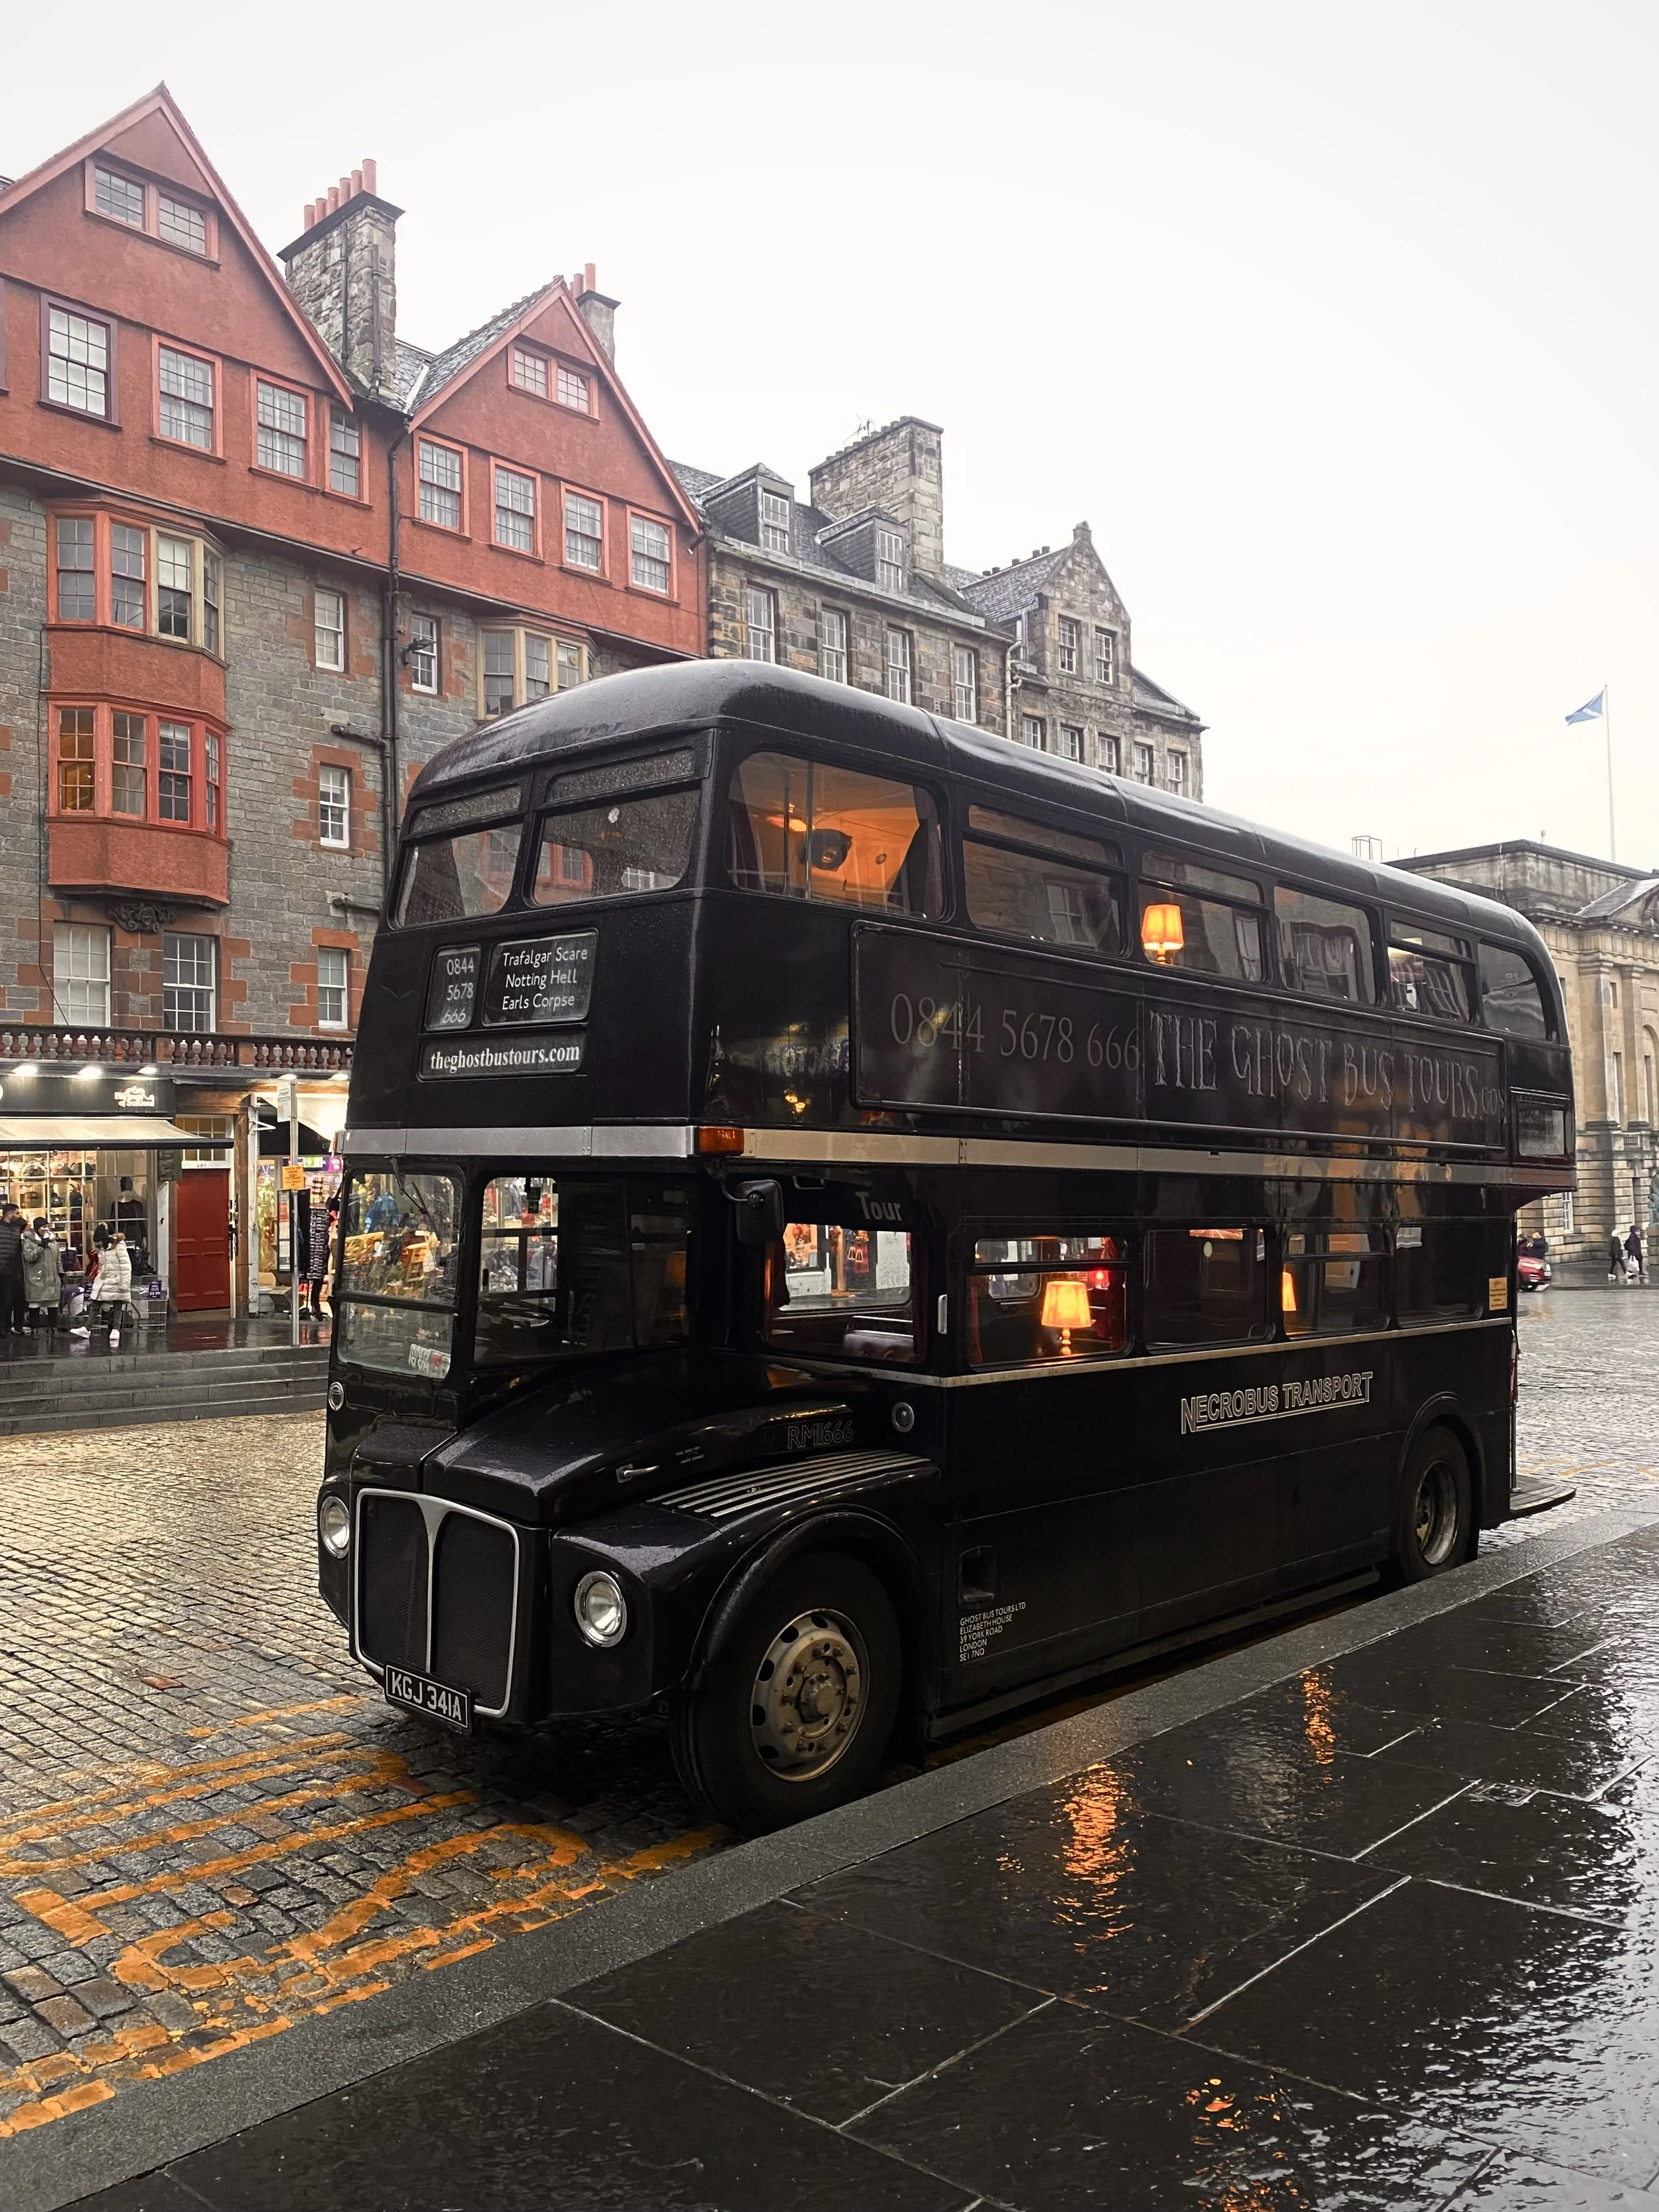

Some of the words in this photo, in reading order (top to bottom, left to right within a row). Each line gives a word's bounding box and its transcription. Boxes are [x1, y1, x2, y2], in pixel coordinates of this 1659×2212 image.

[447, 957, 474, 976] 0844
[503, 949, 552, 968] Trafalgar
[555, 946, 588, 962] Scare
[505, 973, 547, 990] Notting
[550, 968, 577, 984] Hell
[446, 982, 473, 1001] 5678
[502, 994, 530, 1010] Earls
[532, 993, 575, 1011] Corpse
[442, 1008, 466, 1023] 666
[891, 993, 985, 1053] 0844
[1000, 1009, 1074, 1063] 5678
[1086, 1021, 1141, 1070] 666
[431, 1045, 580, 1074] theghostbustours.com
[1150, 1009, 1218, 1091] THE
[1232, 1024, 1333, 1103] GHOST
[1343, 1041, 1394, 1111] BUS
[854, 1191, 902, 1221] Tour
[1181, 1385, 1279, 1435] NECROBUS
[1282, 1371, 1374, 1408] TRANSPORT
[960, 1613, 981, 1626] GHOST
[982, 1610, 994, 1620] BUS
[995, 1605, 1015, 1615] TOURS
[1015, 1601, 1026, 1611] LTD
[960, 1620, 991, 1635] ELIZABETH
[992, 1614, 1013, 1625] HOUSE
[960, 1635, 968, 1644] 39
[968, 1631, 985, 1641] YORK
[985, 1625, 1003, 1637] ROAD
[960, 1638, 987, 1653] LONDON
[971, 1648, 985, 1658] 7NQ
[392, 1671, 423, 1704] KGJ
[427, 1685, 462, 1721] 341A
